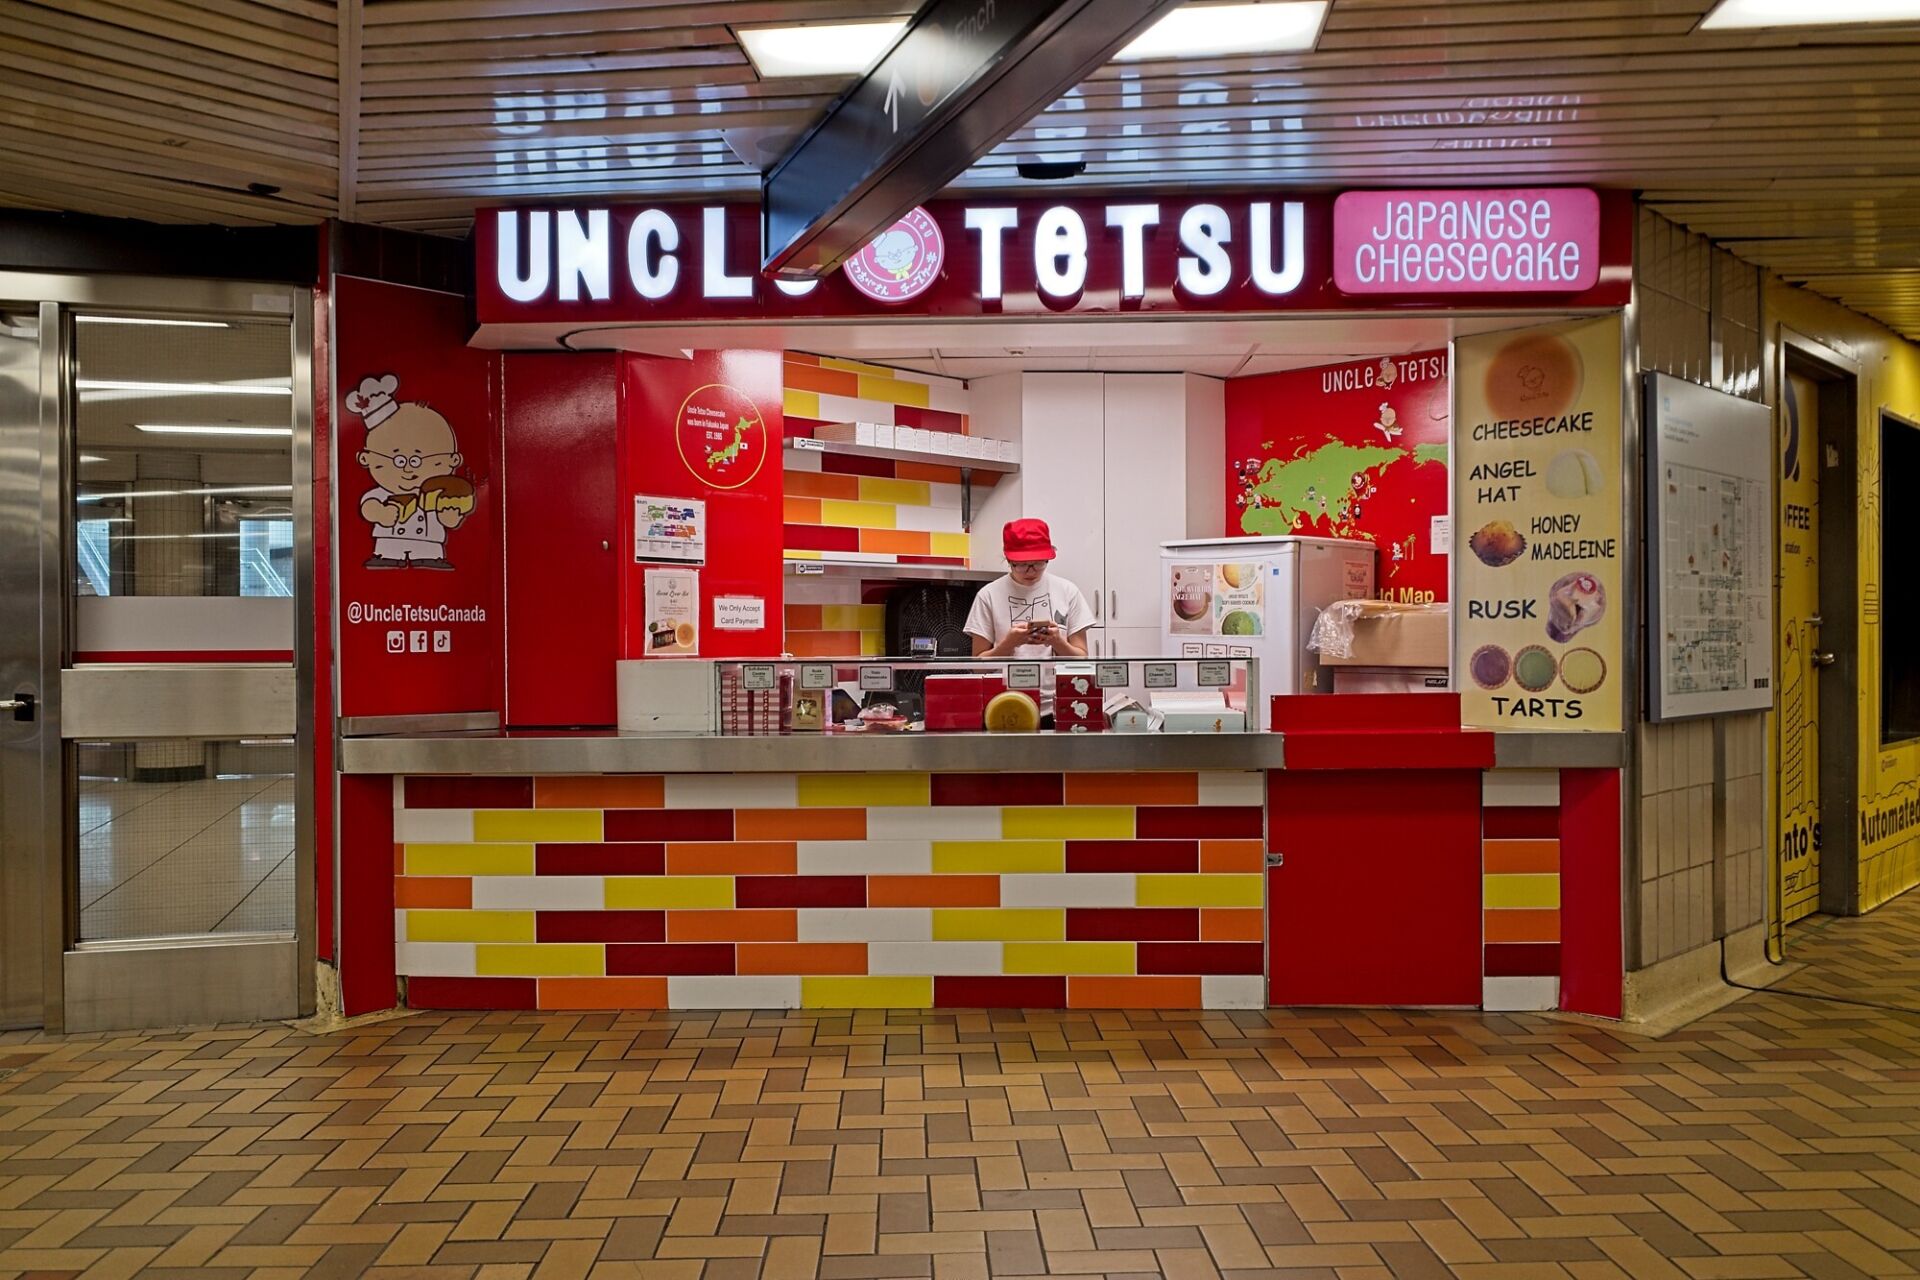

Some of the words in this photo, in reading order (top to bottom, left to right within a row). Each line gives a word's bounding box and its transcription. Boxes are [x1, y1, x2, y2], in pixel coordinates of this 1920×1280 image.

[497, 206, 819, 302] UNCL
[1472, 411, 1593, 442] CHEESECAKE
[1469, 459, 1537, 481] ANGEL
[1477, 485, 1522, 504] HAT
[1531, 513, 1581, 536] HONEY
[1784, 503, 1810, 530] FFEE
[1531, 538, 1616, 561] MADELEINE
[1400, 587, 1435, 603] Map
[347, 601, 486, 624] @UncleTetsuCanada
[729, 604, 742, 613] Only
[742, 604, 761, 612] Accept
[1468, 599, 1537, 620] RUSK
[735, 617, 759, 626] Payment
[1491, 696, 1584, 719] TARTS
